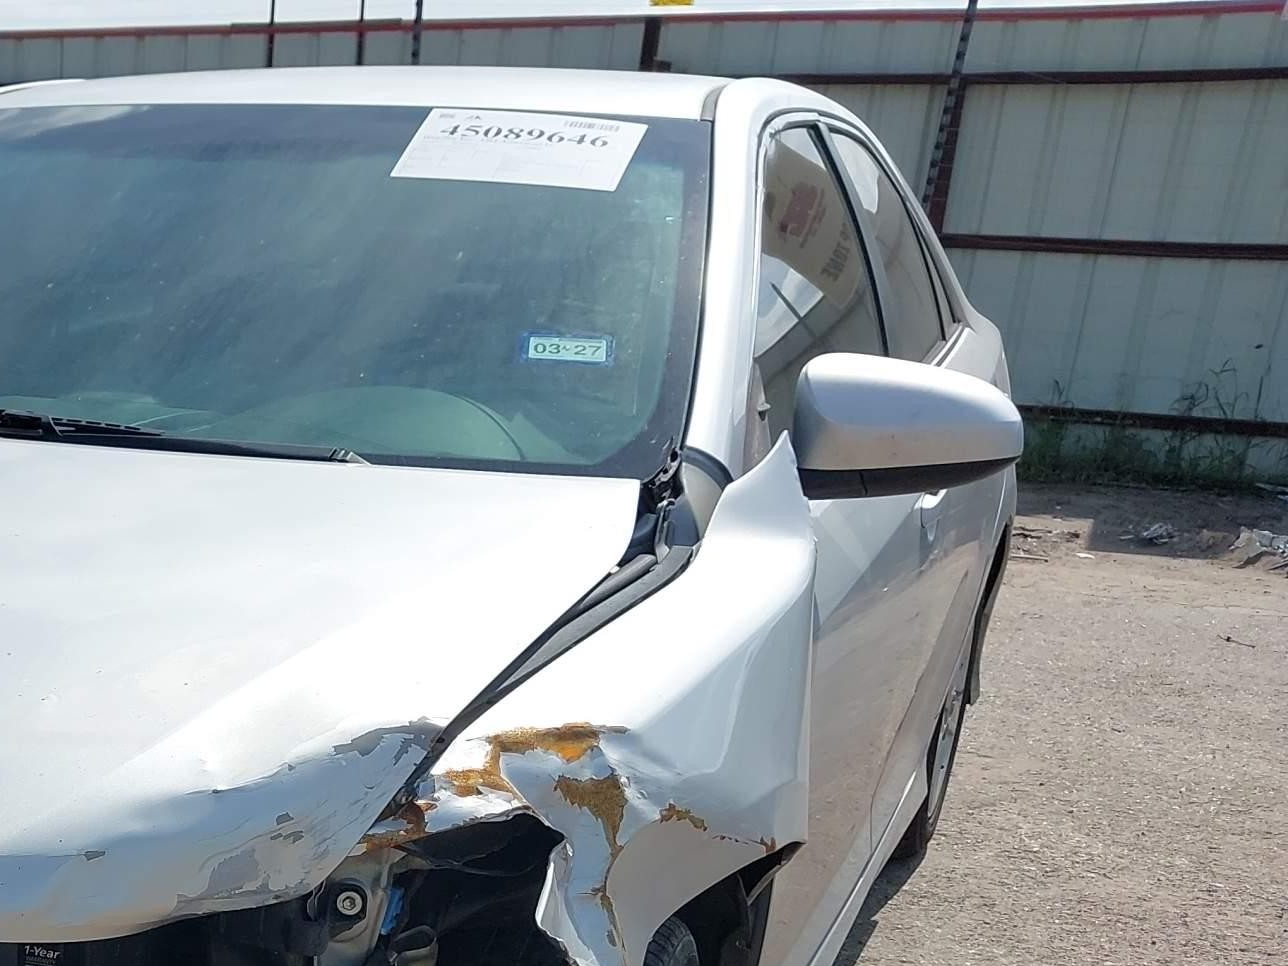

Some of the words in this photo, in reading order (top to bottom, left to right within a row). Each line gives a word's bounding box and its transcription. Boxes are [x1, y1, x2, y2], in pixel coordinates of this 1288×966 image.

[440, 123, 609, 148] 45089646
[533, 343, 561, 354] 03
[573, 344, 601, 356] 27
[24, 944, 61, 959] 1-Year
